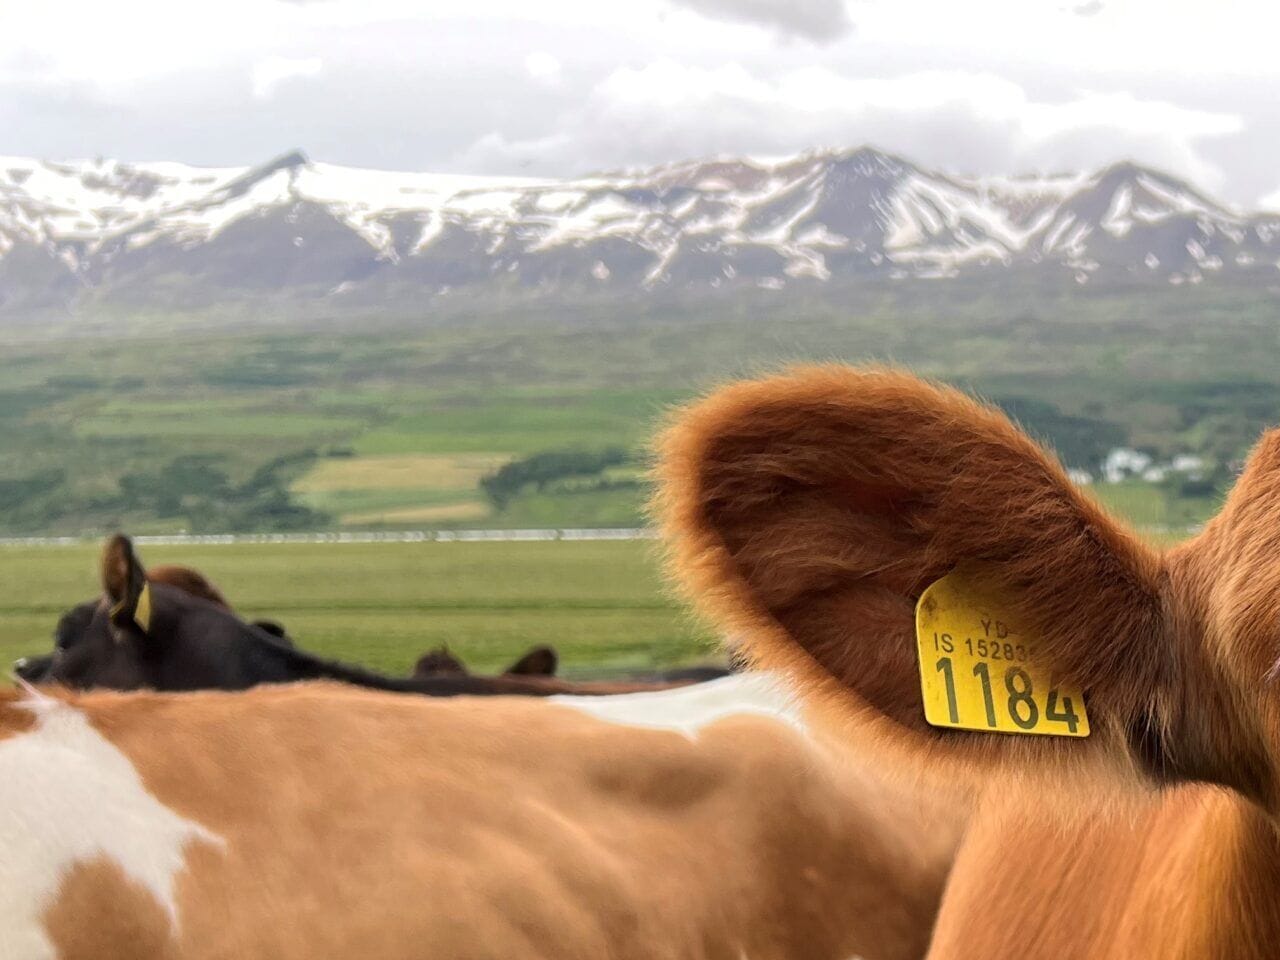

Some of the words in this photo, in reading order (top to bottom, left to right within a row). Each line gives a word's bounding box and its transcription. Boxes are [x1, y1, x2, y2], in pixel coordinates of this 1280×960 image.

[934, 632, 954, 653] IS
[965, 638, 1033, 663] 15283
[936, 657, 1079, 733] 1184
